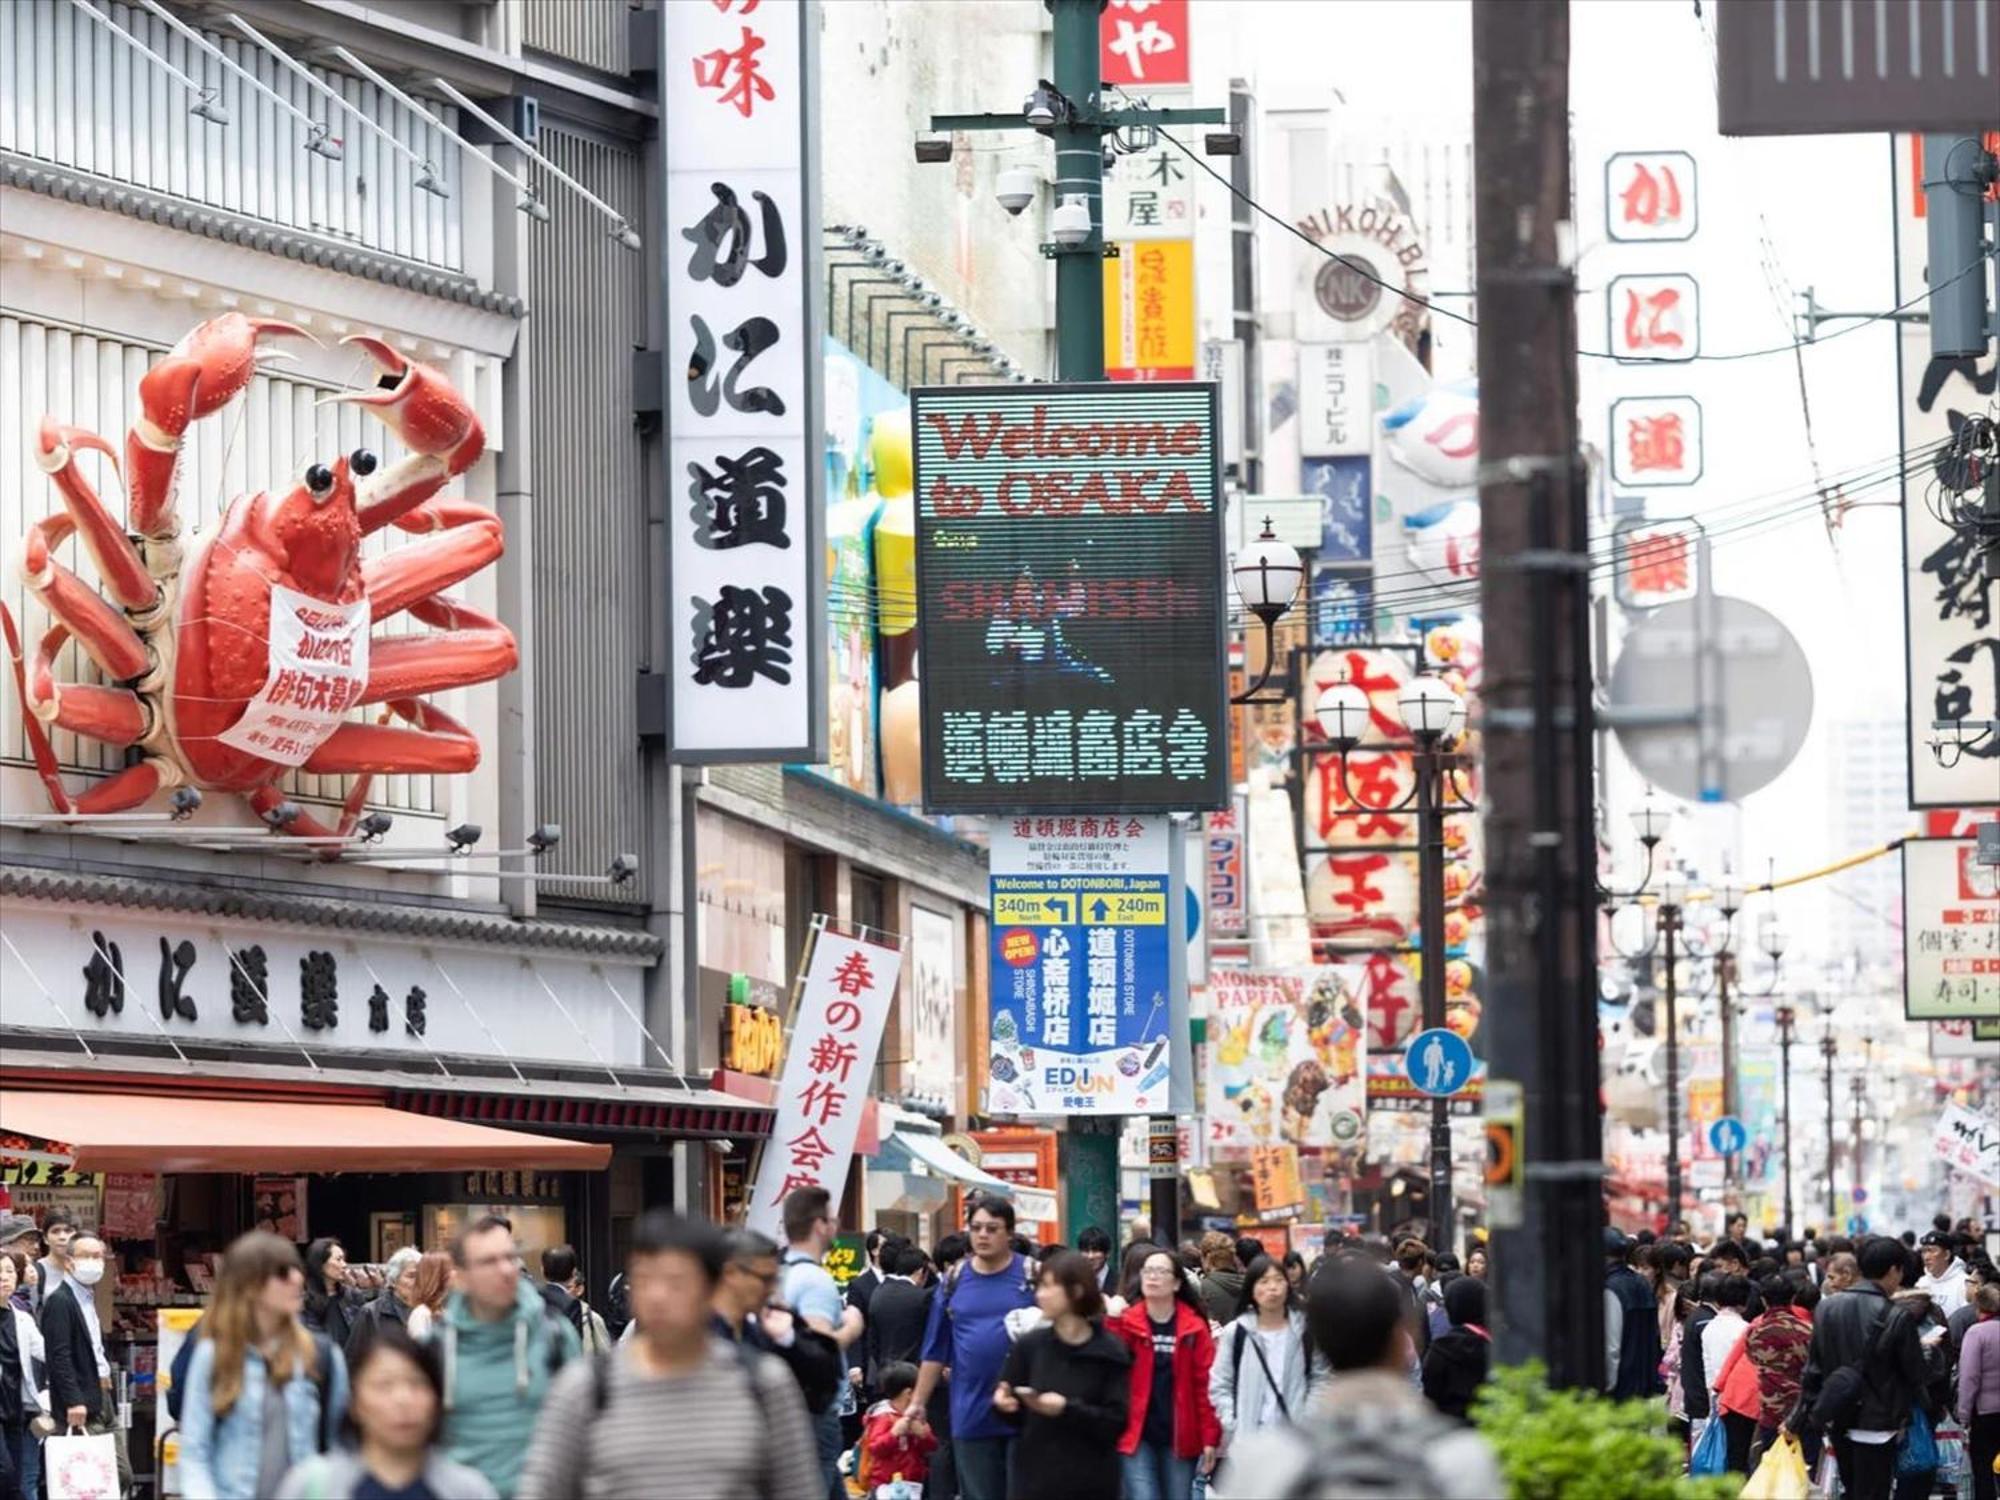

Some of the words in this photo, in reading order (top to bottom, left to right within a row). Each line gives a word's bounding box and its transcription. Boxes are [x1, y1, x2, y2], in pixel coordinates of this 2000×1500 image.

[1297, 204, 1402, 247] NIKOH
[924, 405, 1202, 460] Welcome
[931, 475, 985, 517] to
[997, 470, 1207, 516] OSAKA
[1013, 817, 1145, 838] 道頓堀商店会
[996, 879, 1044, 889] Welcome
[1047, 879, 1058, 889] to
[1130, 879, 1161, 891] Japan
[1000, 899, 1041, 912] 340m
[1117, 898, 1159, 912] 240m
[1005, 935, 1030, 948] NEW
[1013, 969, 1024, 999] STORE
[1123, 985, 1134, 1016] STORE
[1045, 1068, 1115, 1093] EDION
